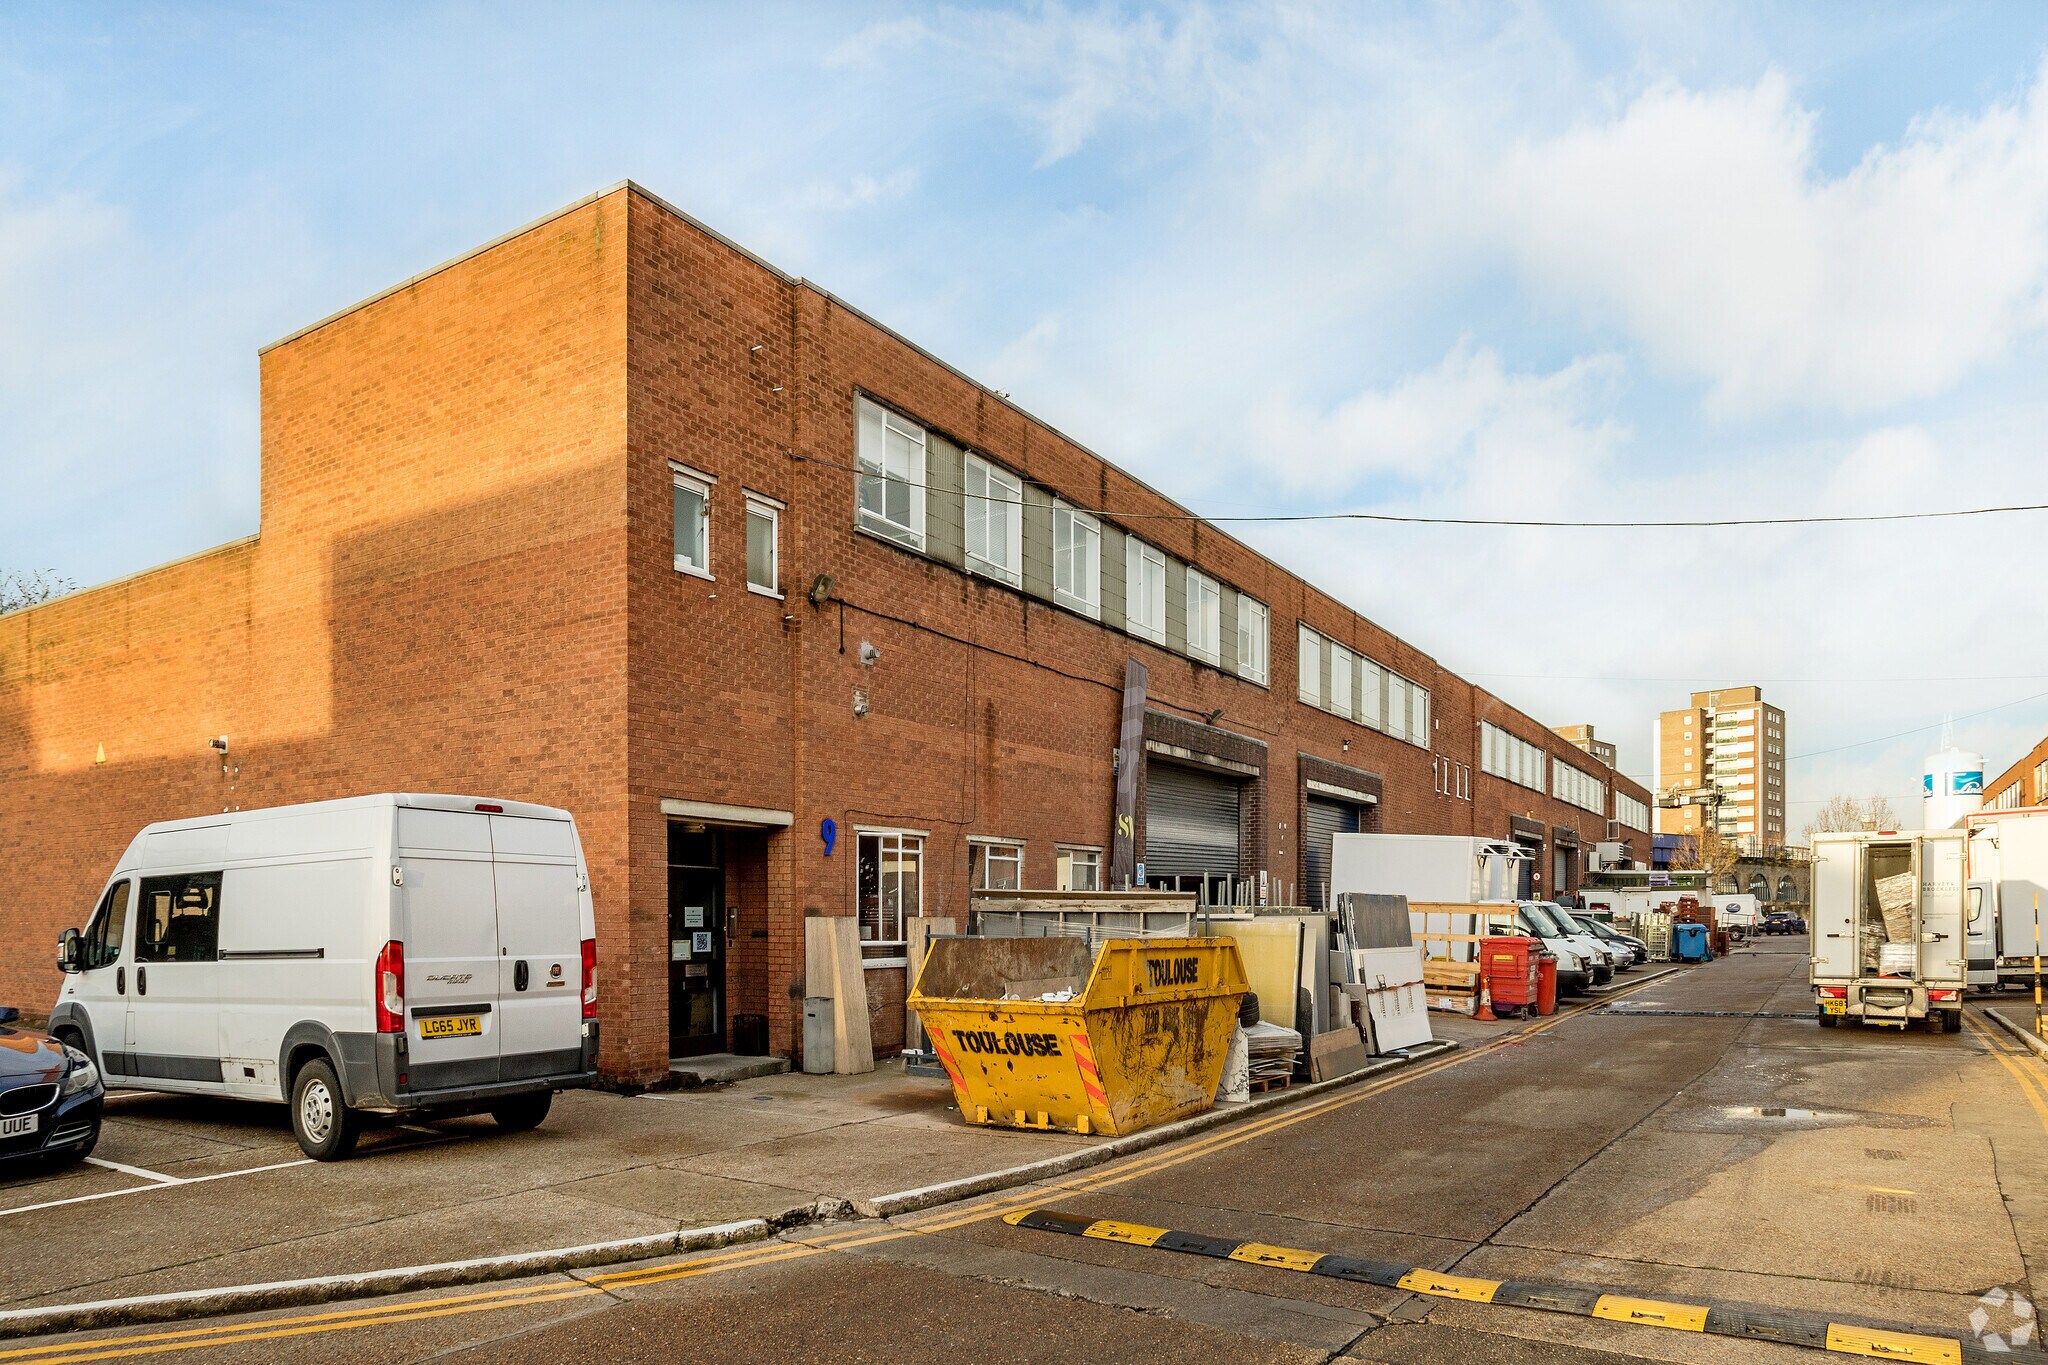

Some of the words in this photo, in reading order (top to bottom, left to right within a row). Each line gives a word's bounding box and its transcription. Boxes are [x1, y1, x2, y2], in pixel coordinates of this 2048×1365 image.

[821, 818, 836, 856] 9
[1146, 957, 1199, 987] TOULOUSE
[424, 1019, 454, 1034] LG65
[456, 1018, 477, 1031] JYR
[951, 1029, 1063, 1057] TOULOUSE
[3, 1116, 32, 1135] UUE
